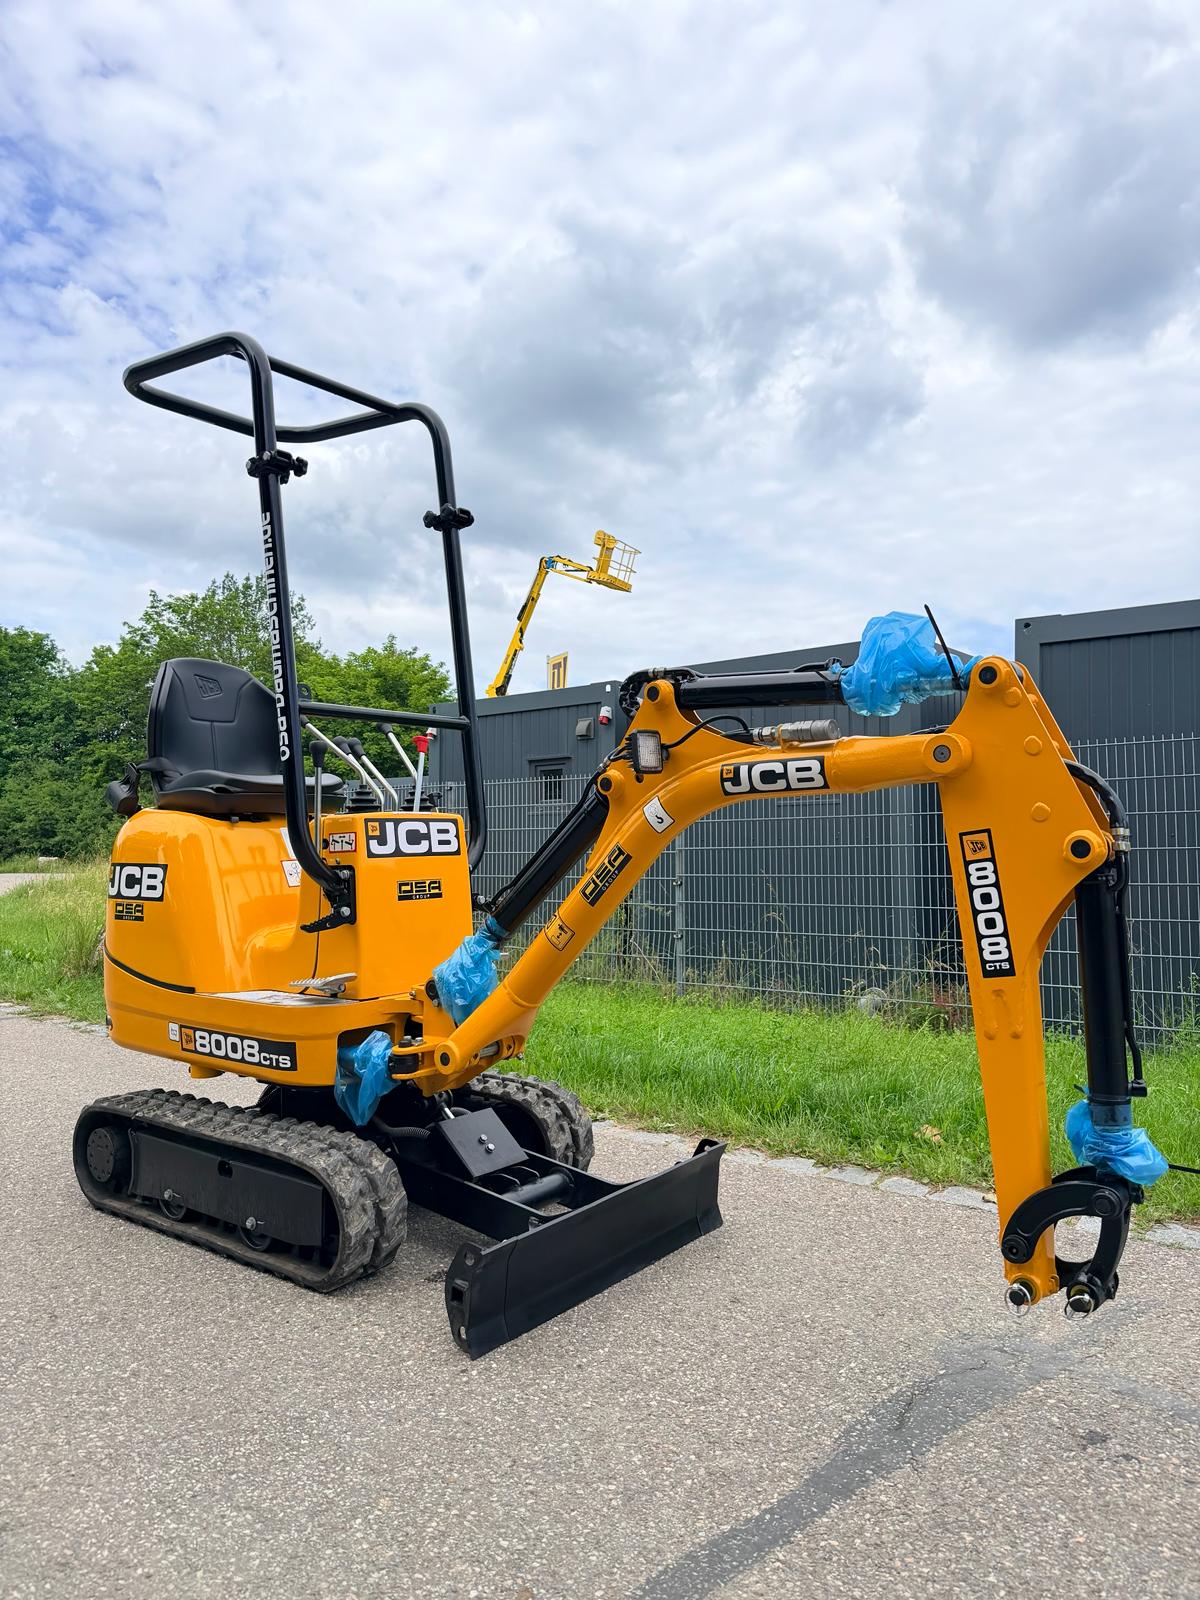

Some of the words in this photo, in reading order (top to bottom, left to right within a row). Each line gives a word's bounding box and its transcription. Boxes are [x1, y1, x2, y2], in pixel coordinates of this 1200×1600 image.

[723, 759, 825, 794] JCB
[369, 821, 459, 855] JCB
[108, 865, 164, 898] JCB
[967, 861, 1010, 961] 8008
[985, 961, 1011, 971] CTS
